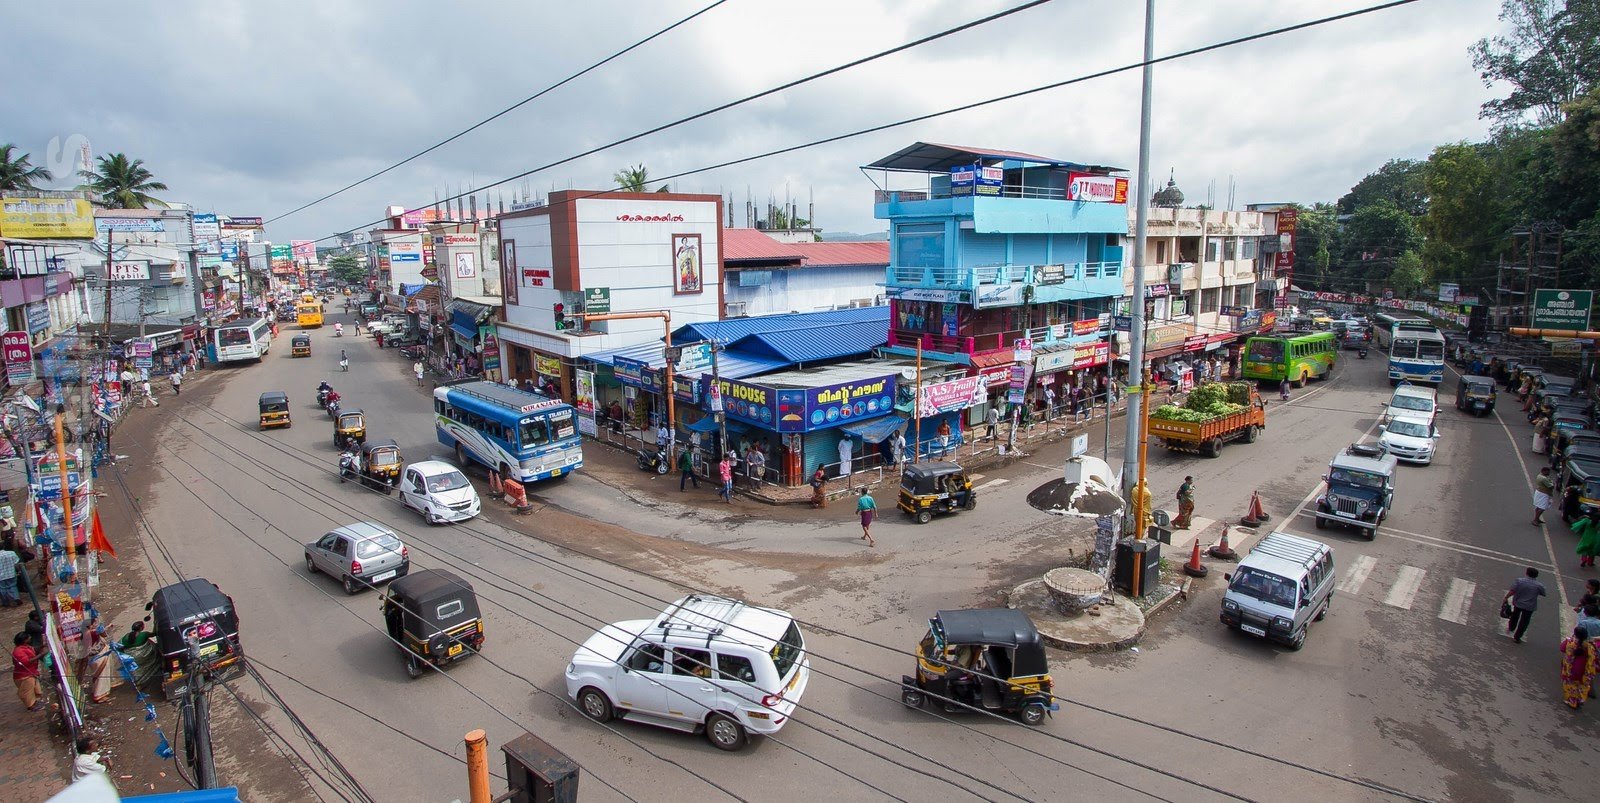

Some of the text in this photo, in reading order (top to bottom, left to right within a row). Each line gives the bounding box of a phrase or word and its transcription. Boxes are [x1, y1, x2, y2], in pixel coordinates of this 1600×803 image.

[1089, 182, 1113, 198] INDUSTRIES
[115, 264, 139, 273] PTS
[733, 386, 766, 404] HOUSE
[523, 399, 561, 411] NIRANJANA
[548, 409, 572, 419] TRAVELS
